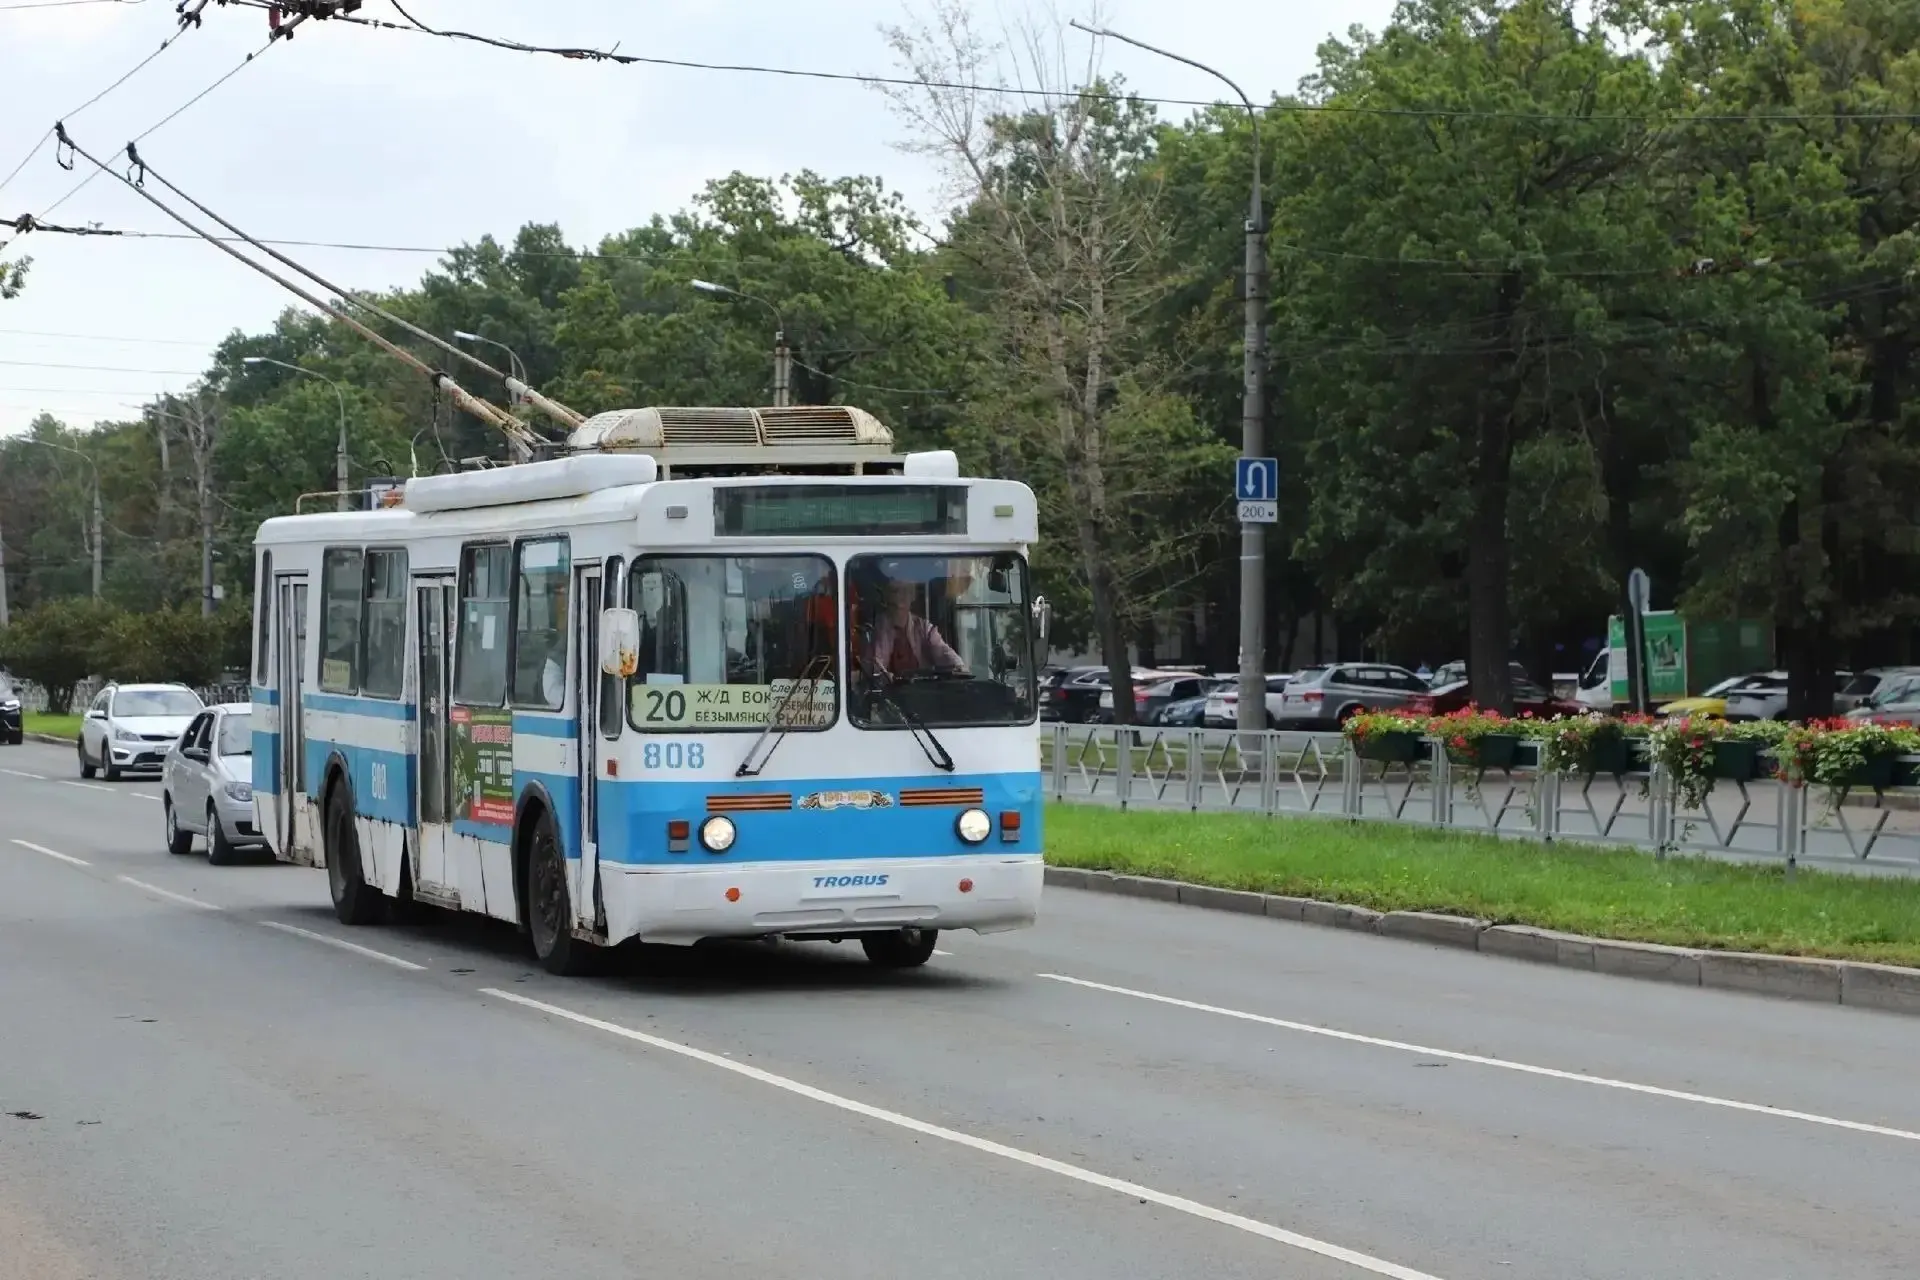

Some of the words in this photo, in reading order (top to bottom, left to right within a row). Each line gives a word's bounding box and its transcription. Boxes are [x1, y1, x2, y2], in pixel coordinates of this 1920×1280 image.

[1242, 506, 1265, 518] 200
[697, 690, 730, 704] Ж/Д
[646, 690, 686, 722] 20
[644, 743, 705, 769] 808
[813, 874, 889, 888] TROBUS
